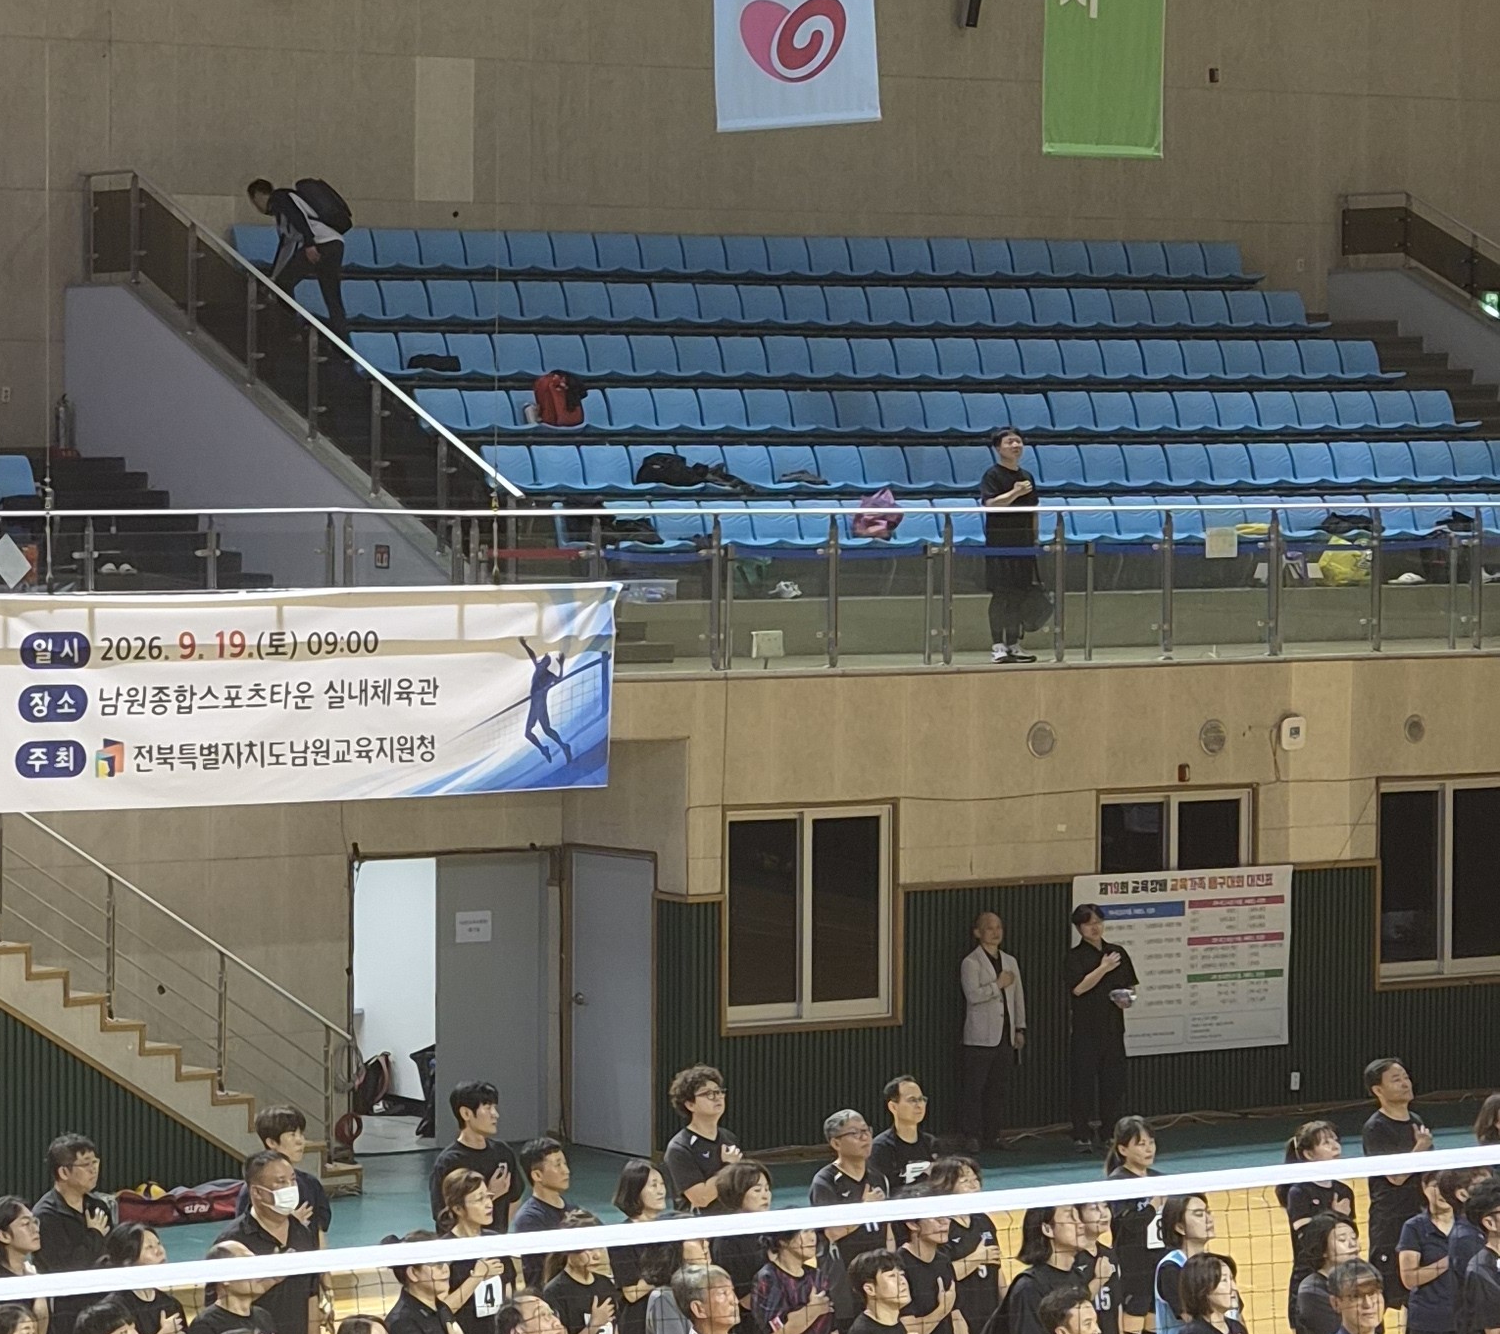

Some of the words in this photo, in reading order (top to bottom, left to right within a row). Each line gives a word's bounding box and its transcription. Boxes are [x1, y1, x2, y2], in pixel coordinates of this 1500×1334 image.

[31, 637, 80, 665] 일시
[100, 636, 170, 662] 2026.
[178, 630, 204, 659] 9.
[307, 629, 379, 656] 09:00
[29, 690, 77, 717] 장소
[99, 681, 315, 717] 남원종합스포츠타운
[323, 677, 440, 709] 실내체육관
[26, 746, 75, 771] 주최
[133, 735, 437, 774] 전북특별자치도남원교육지원청
[484, 1283, 496, 1308] 4
